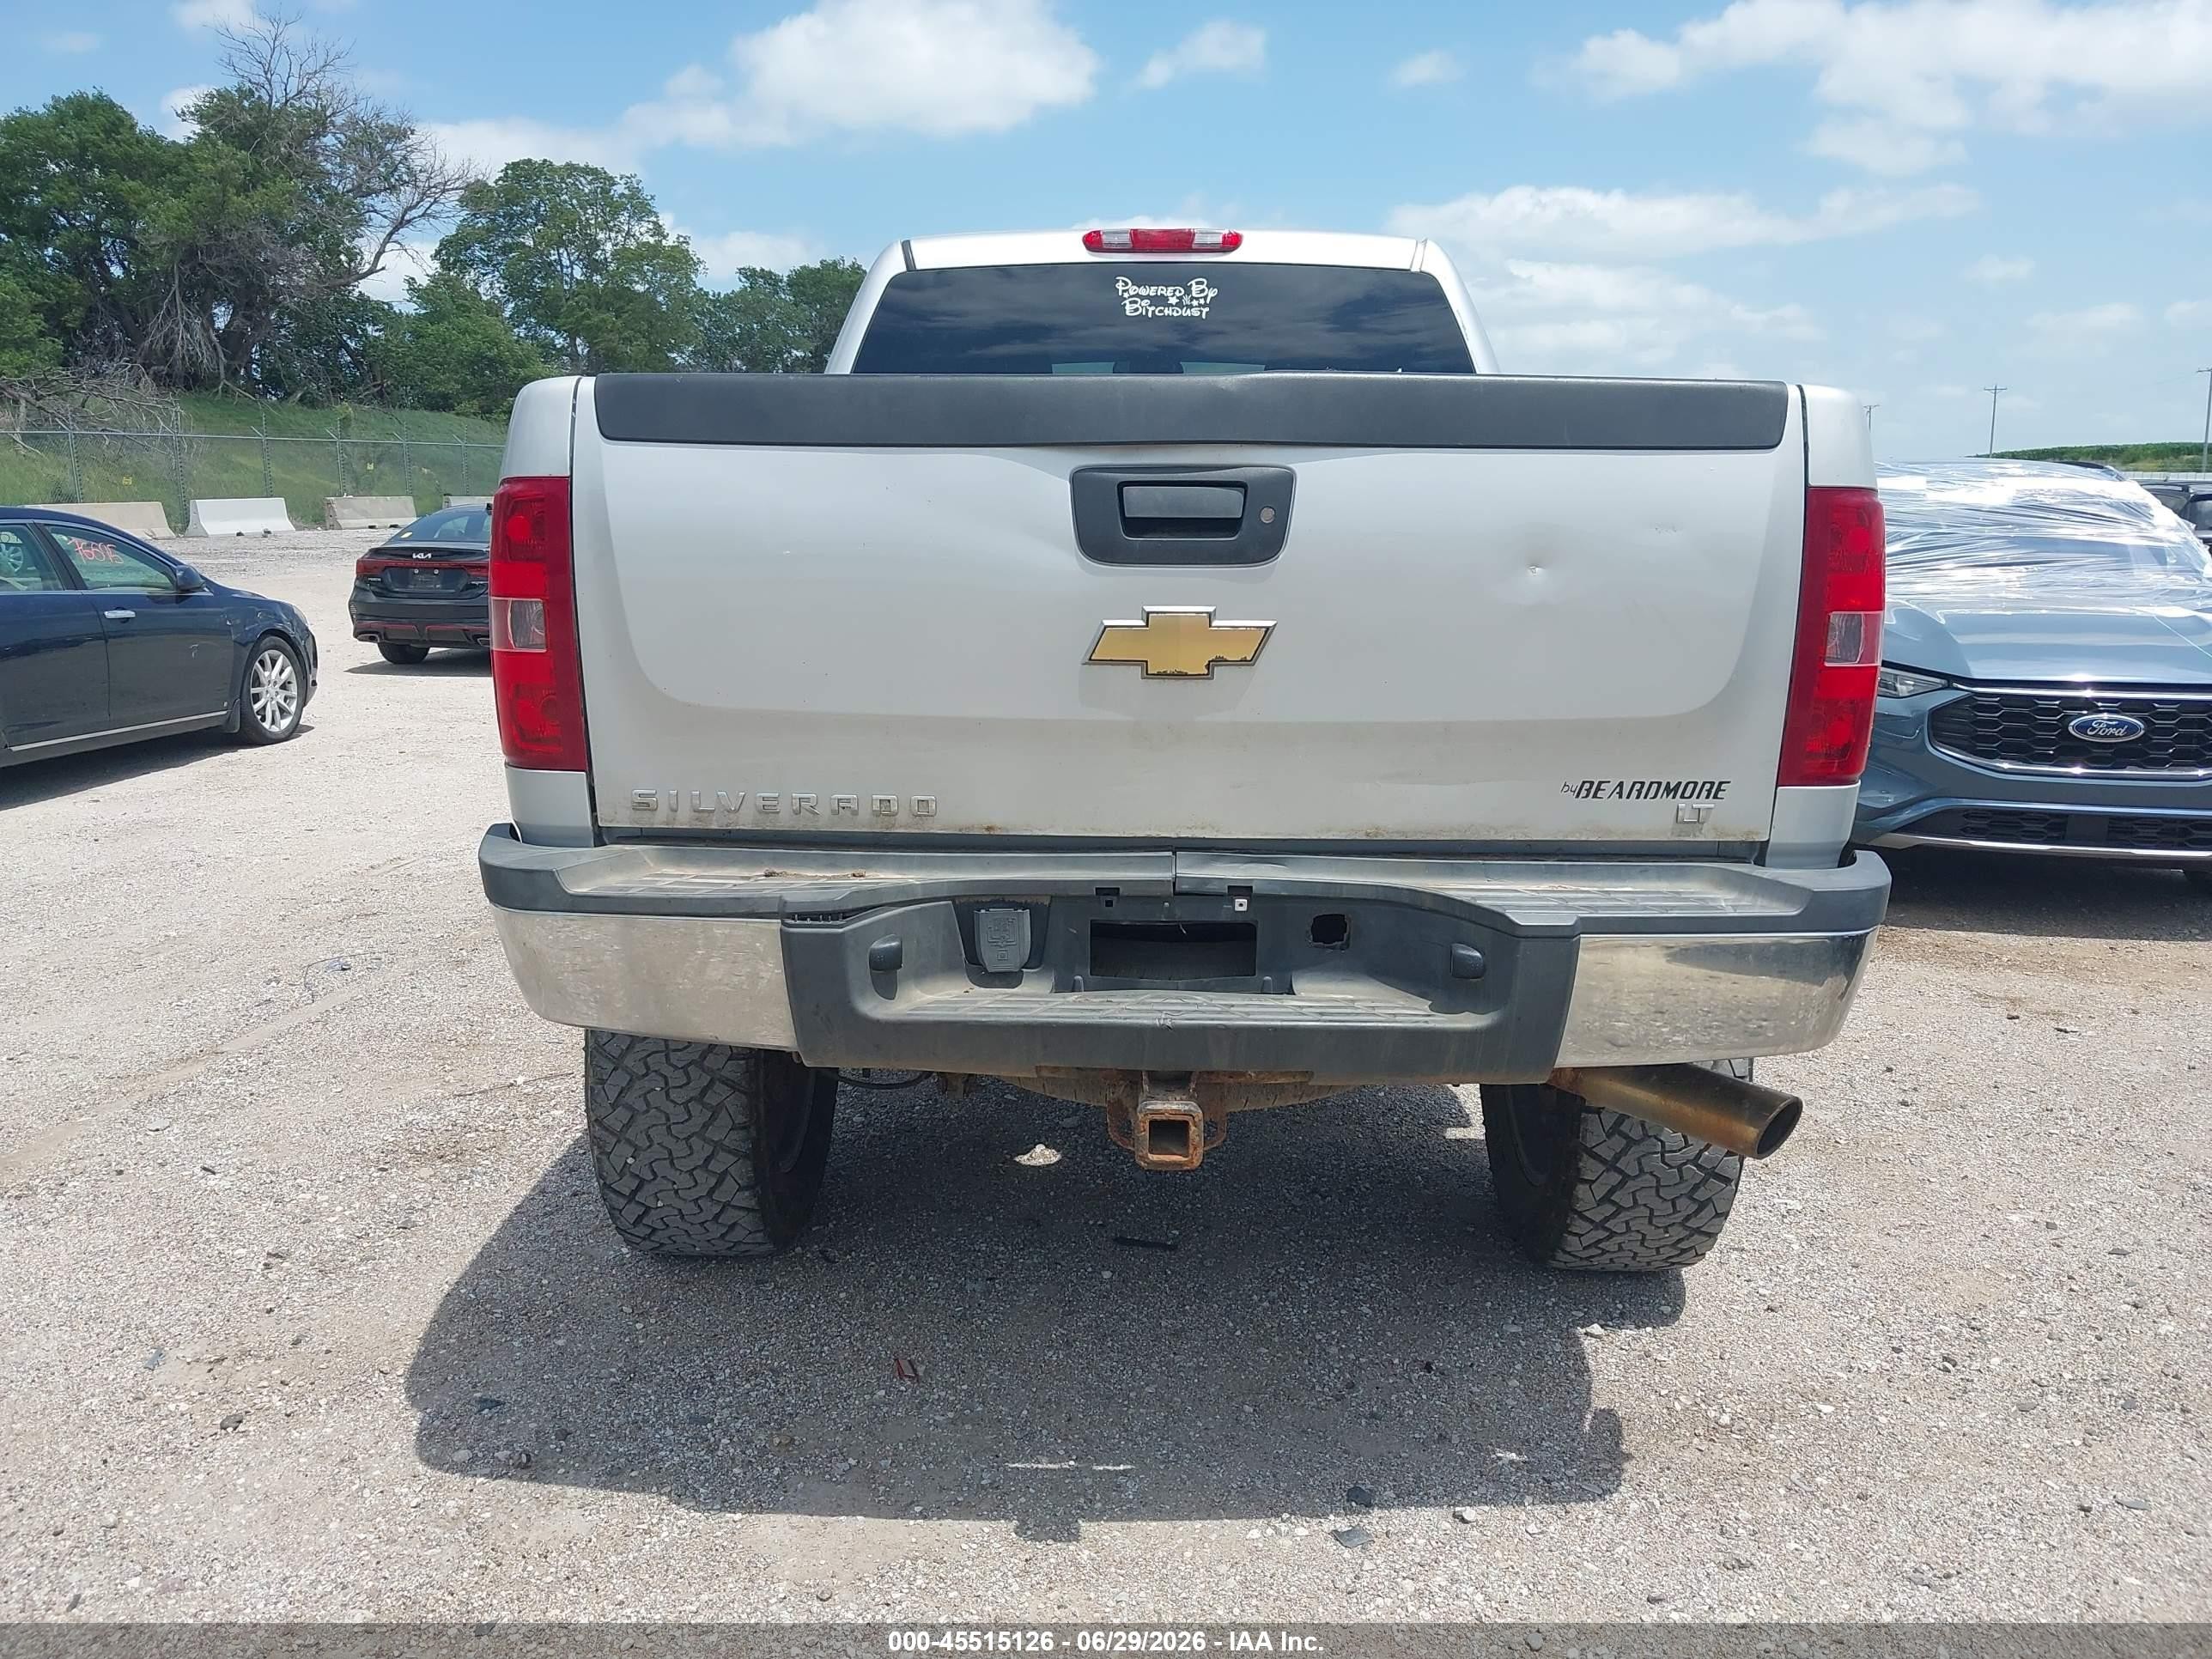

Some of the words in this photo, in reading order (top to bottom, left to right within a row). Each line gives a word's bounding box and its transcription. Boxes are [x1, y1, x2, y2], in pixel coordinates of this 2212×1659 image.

[1187, 277, 1218, 304] By
[2087, 720, 2128, 736] Ford
[1575, 780, 1732, 799] BEARDMORE
[631, 788, 938, 817] SILVERADO
[1675, 803, 1716, 824] LT
